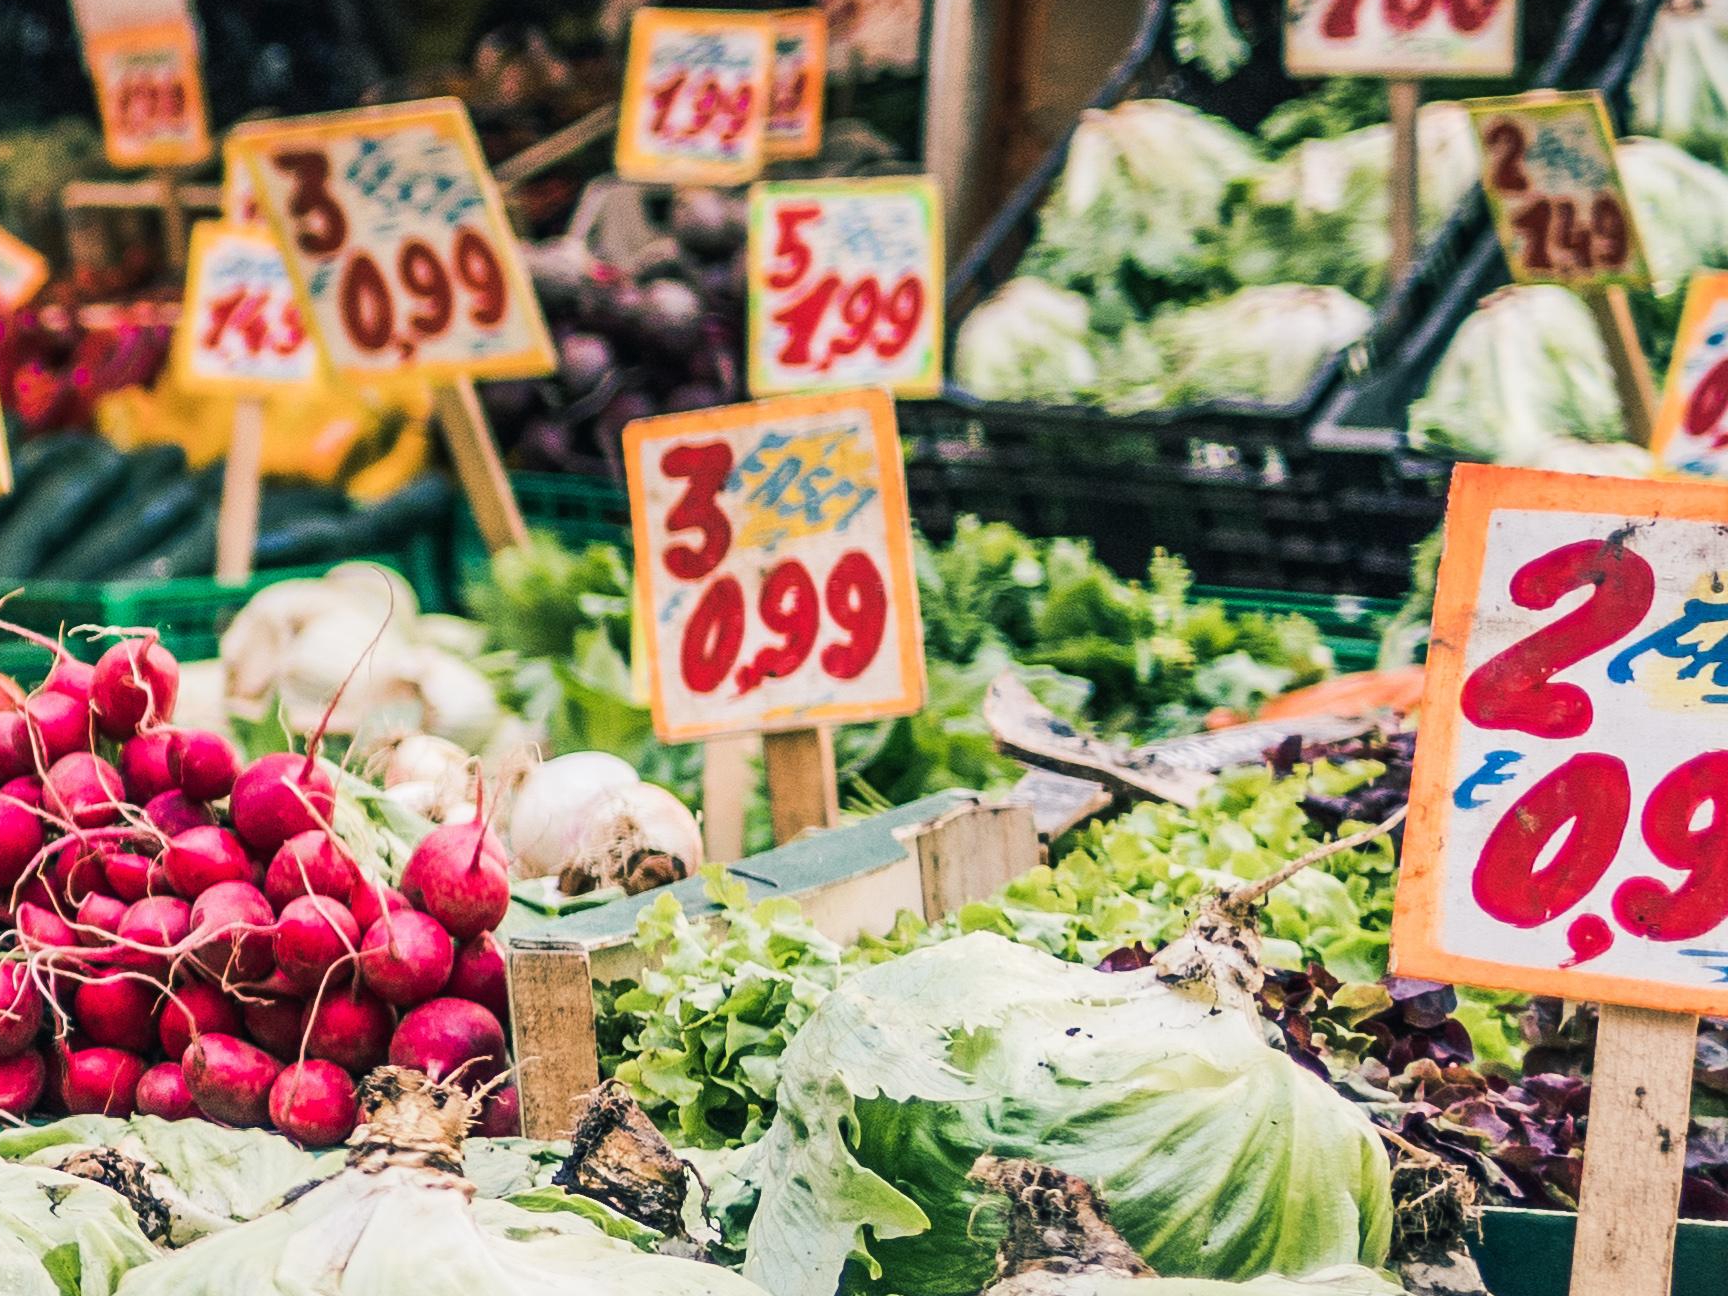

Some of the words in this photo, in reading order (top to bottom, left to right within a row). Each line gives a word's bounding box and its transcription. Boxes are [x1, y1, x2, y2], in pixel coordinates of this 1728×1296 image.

[269, 147, 349, 258] 3
[1484, 119, 1529, 192] 2
[339, 223, 510, 363] 0,99
[764, 199, 822, 290] 5
[772, 267, 925, 373] 1,99
[659, 440, 734, 580] 3
[679, 546, 889, 702] 0,99
[1459, 537, 1656, 740] 2
